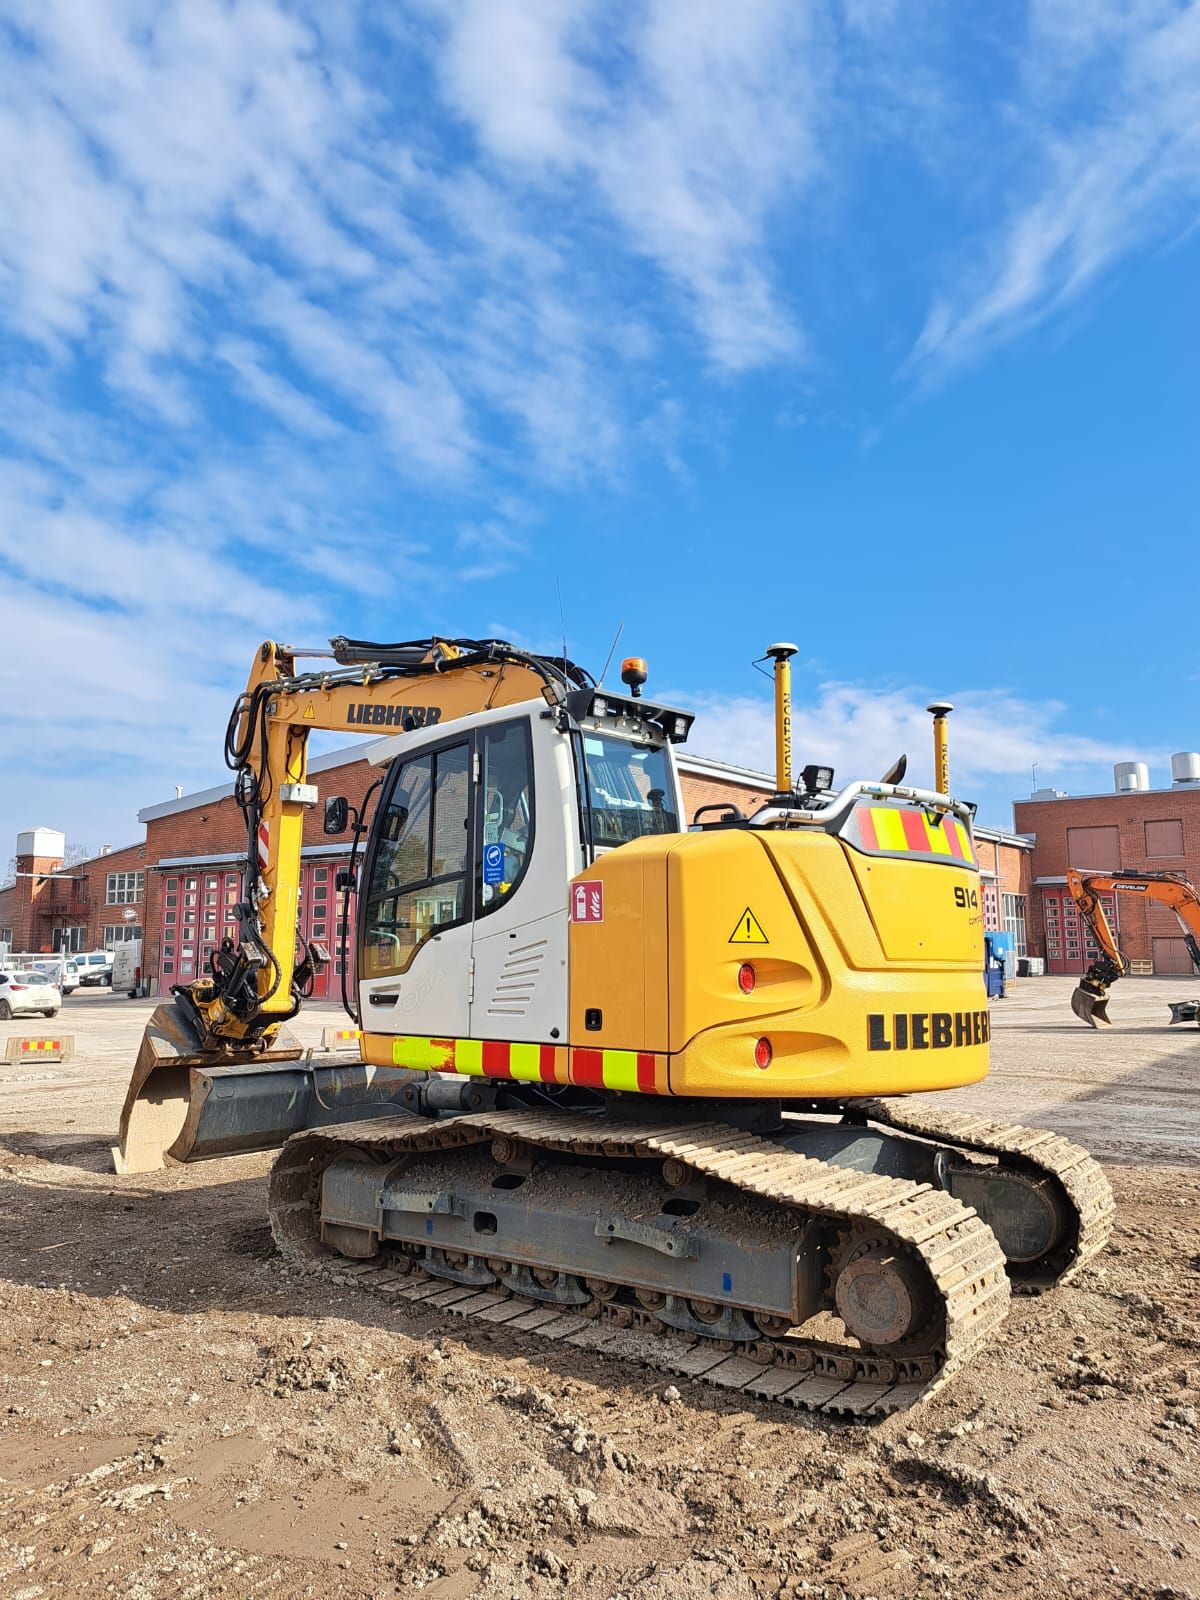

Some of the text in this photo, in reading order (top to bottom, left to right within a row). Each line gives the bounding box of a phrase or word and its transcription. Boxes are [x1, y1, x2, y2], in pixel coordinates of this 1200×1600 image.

[783, 692, 791, 778] NOVATRON
[954, 886, 978, 910] 914
[866, 1010, 991, 1051] LIEBHER
